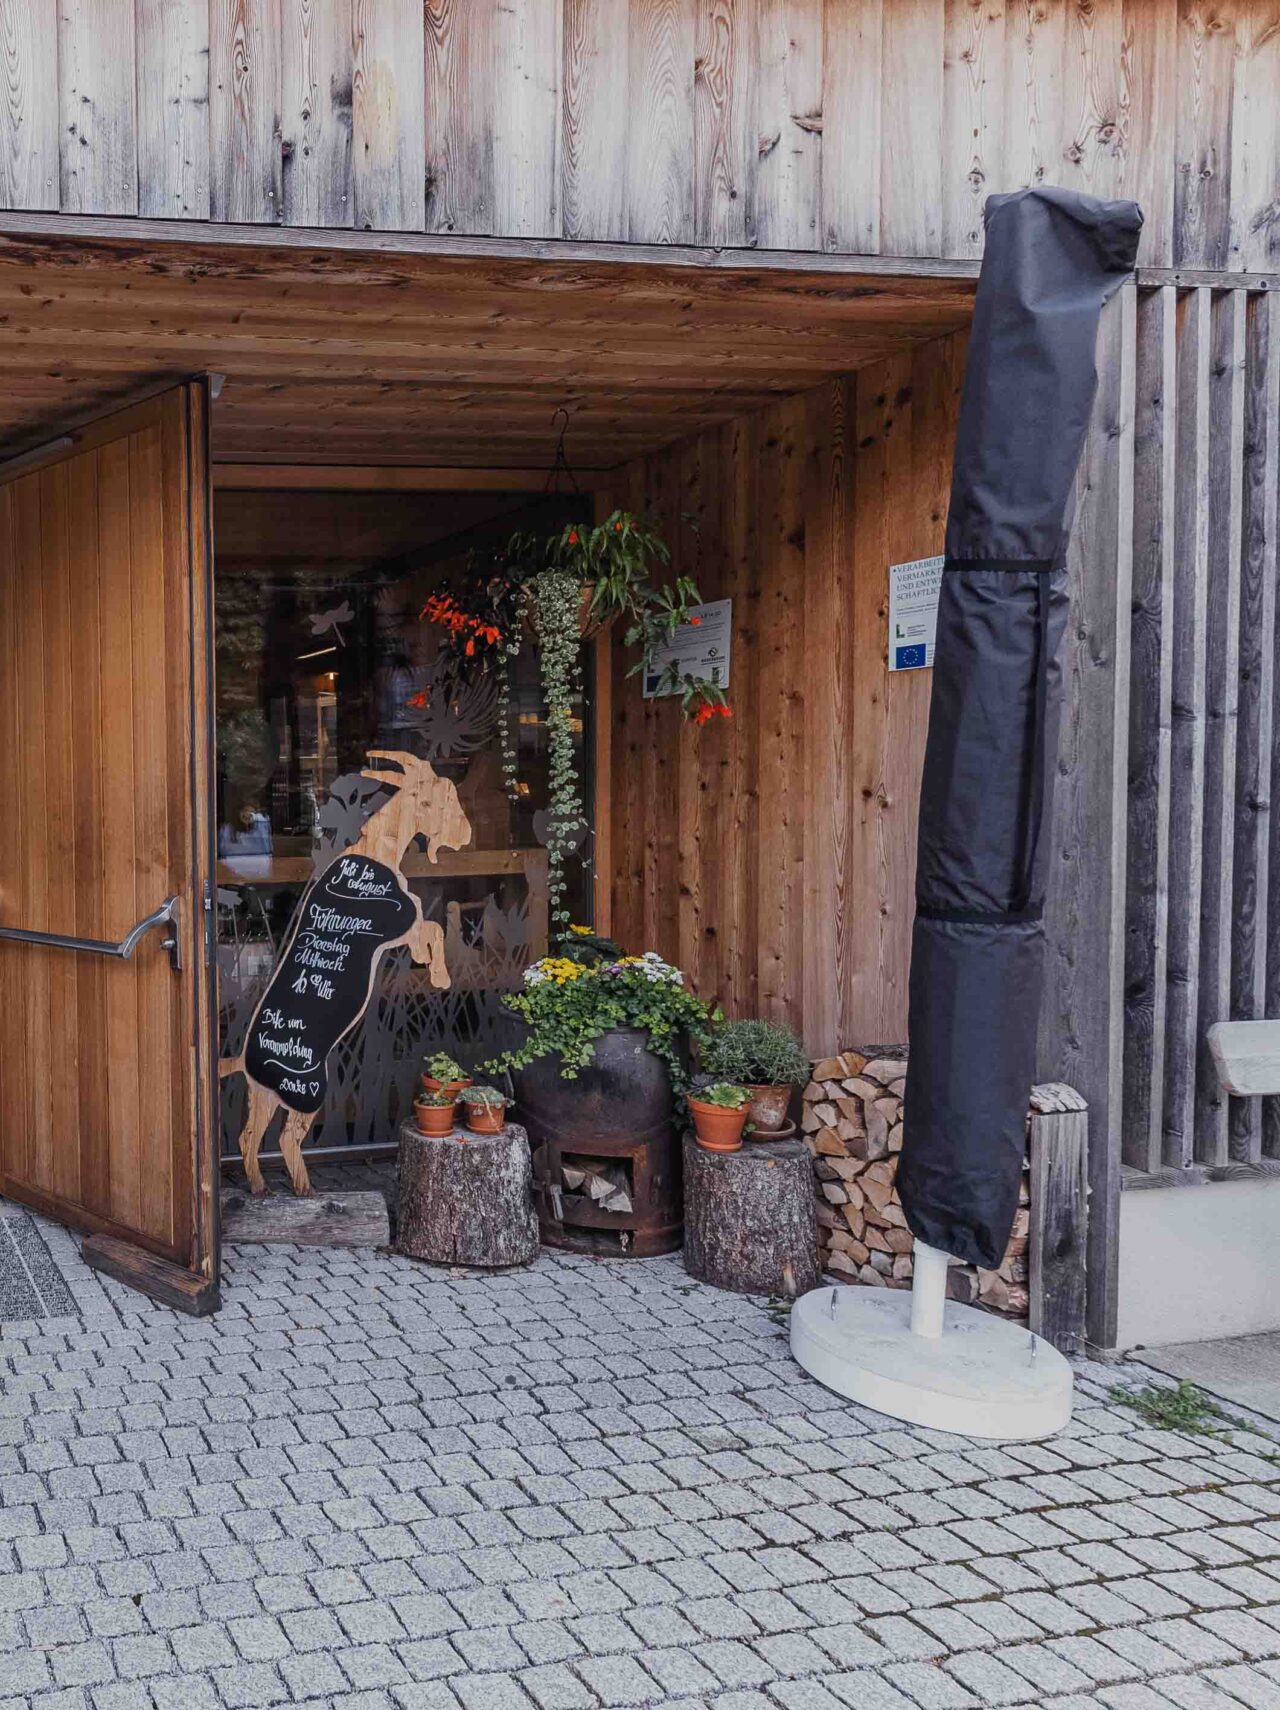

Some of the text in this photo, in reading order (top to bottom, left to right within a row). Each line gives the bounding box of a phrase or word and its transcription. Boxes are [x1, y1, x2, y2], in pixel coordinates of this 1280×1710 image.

[897, 582, 914, 592] UND
[331, 858, 375, 884] Juli bis
[348, 878, 392, 897] August
[310, 903, 372, 938] Führungen
[297, 932, 350, 958] Dienstag
[294, 948, 345, 971] Mittwoch
[317, 980, 336, 1000] Uhr
[261, 1008, 307, 1030] Bitte um
[279, 1077, 306, 1095] Danke
